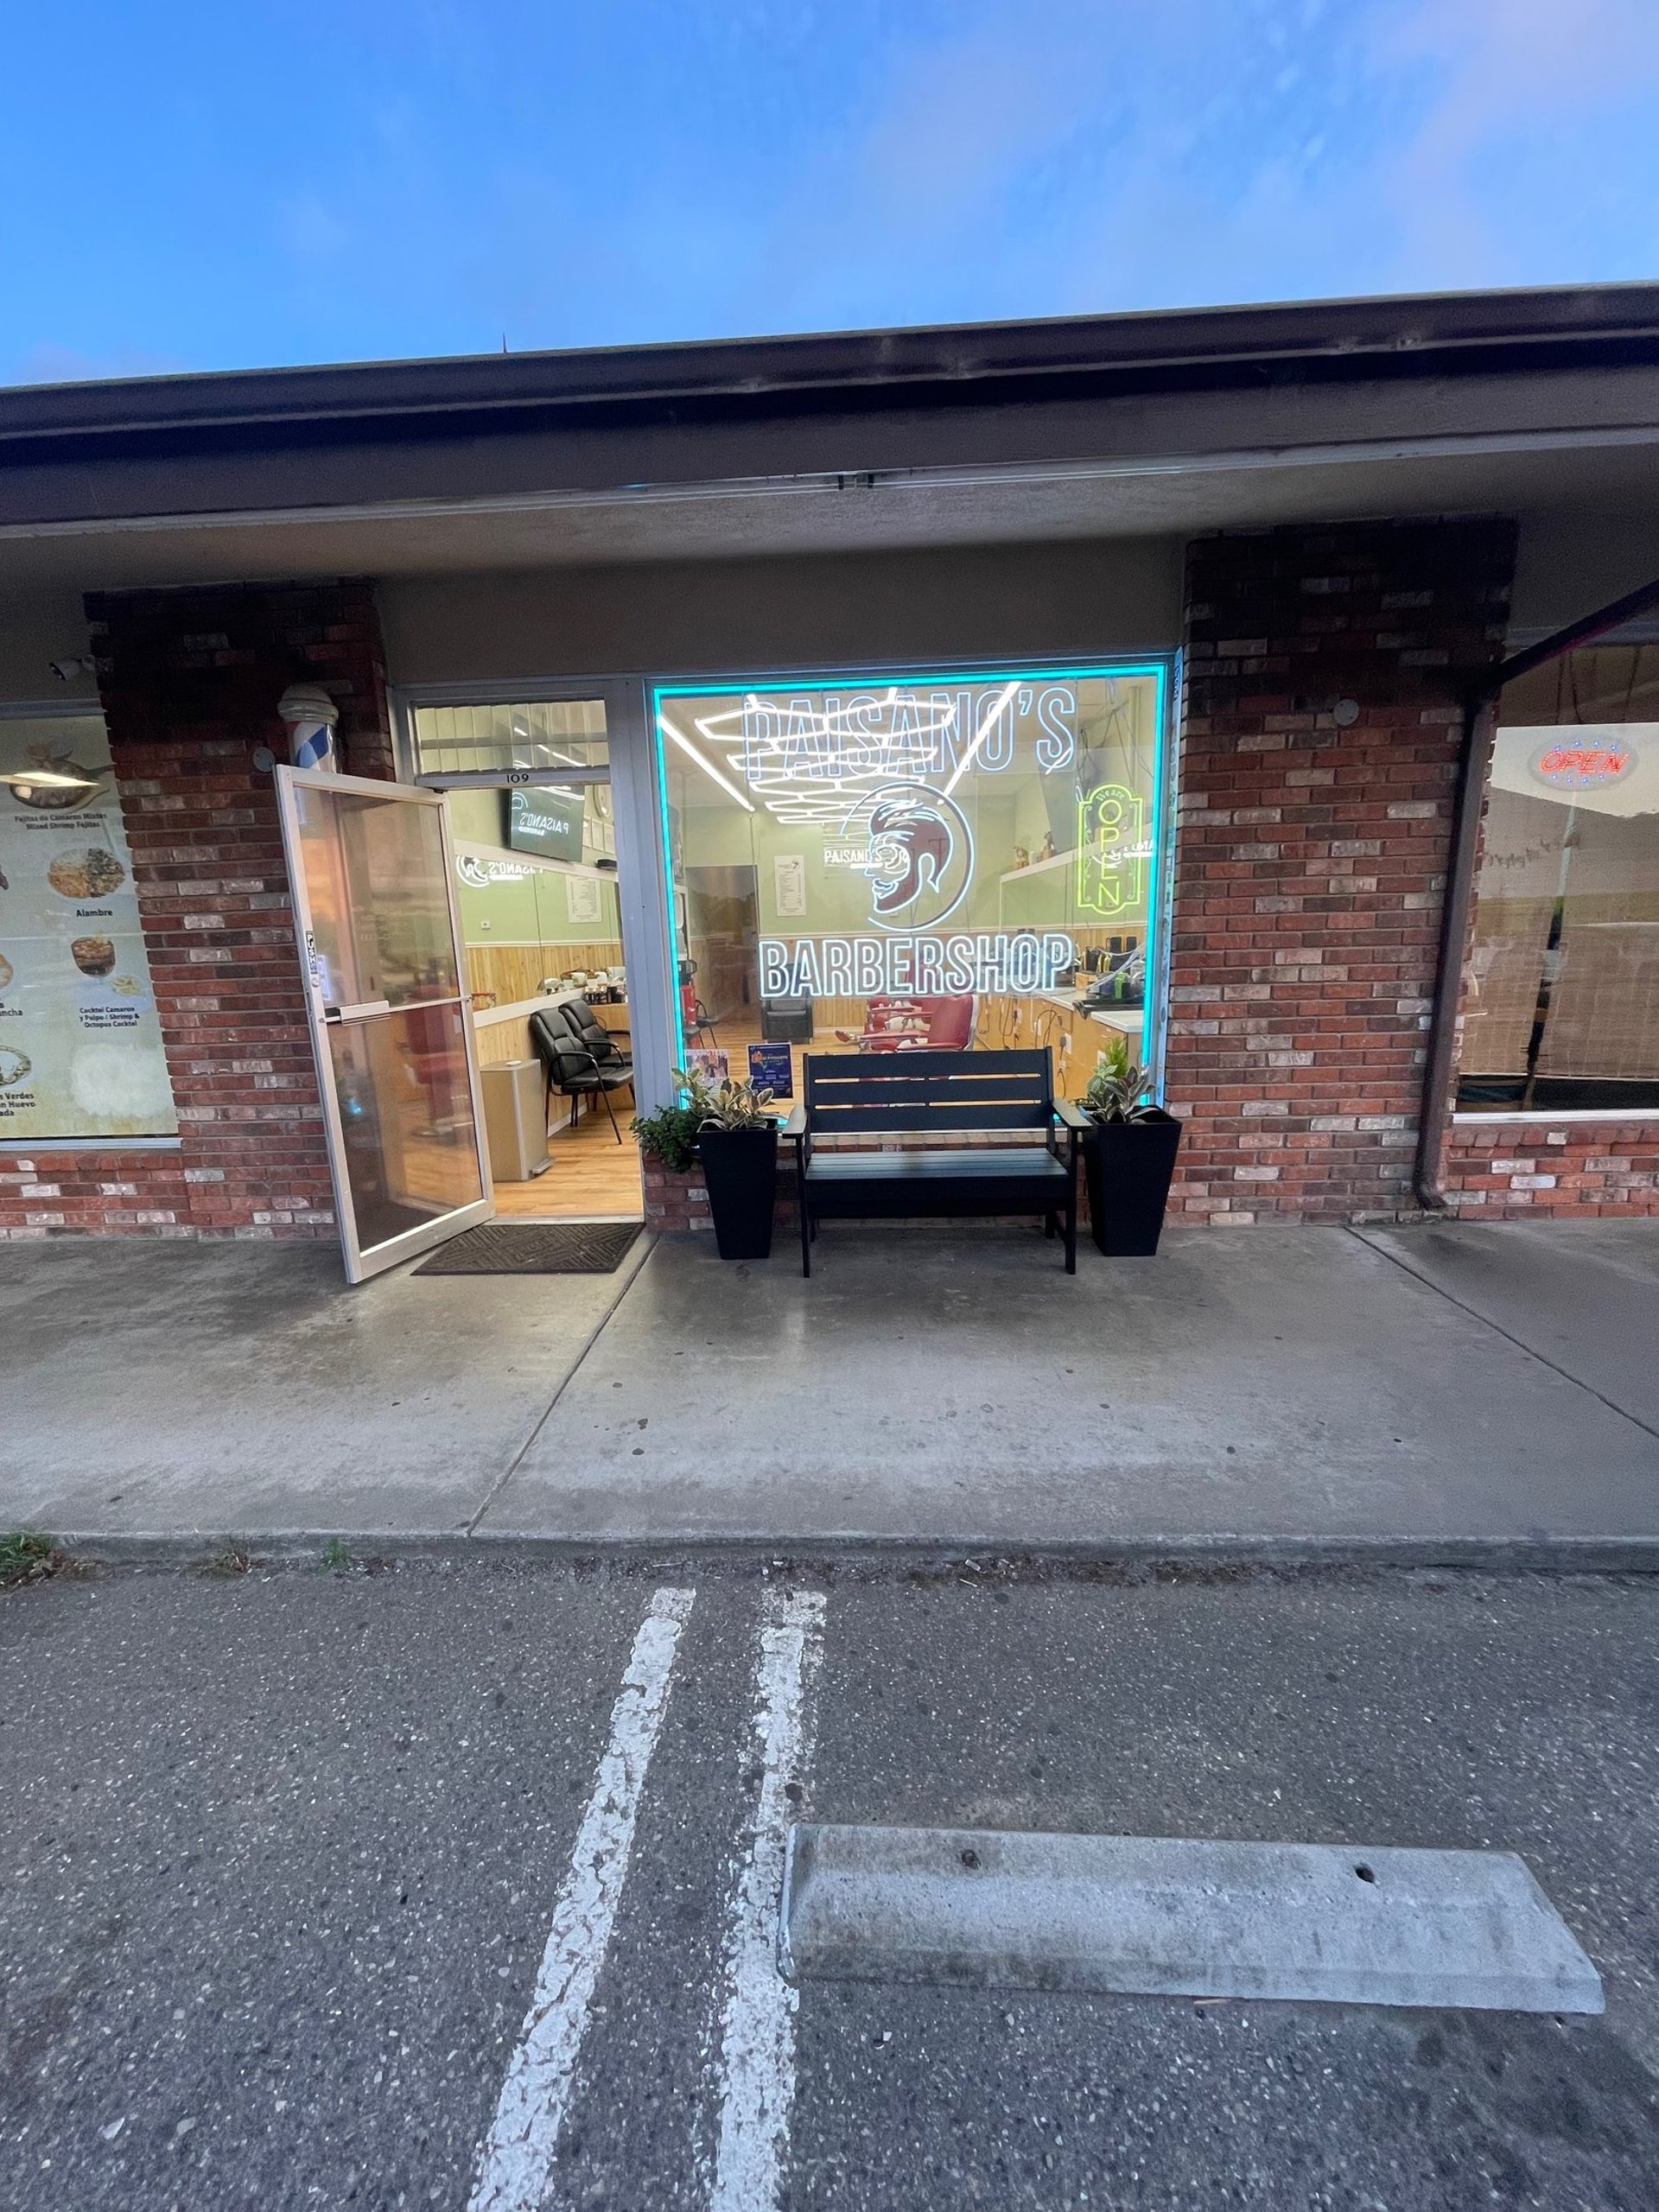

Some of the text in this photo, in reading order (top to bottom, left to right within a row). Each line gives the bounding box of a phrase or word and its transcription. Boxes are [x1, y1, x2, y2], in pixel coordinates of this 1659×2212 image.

[742, 686, 1076, 779] PAISANO'S
[1541, 750, 1631, 774] OPEN
[506, 773, 529, 783] 109
[1097, 799, 1122, 907] OPEN
[76, 908, 113, 917] Alambre
[307, 933, 316, 964] PUSH
[759, 933, 1073, 997] BARBERSHOP
